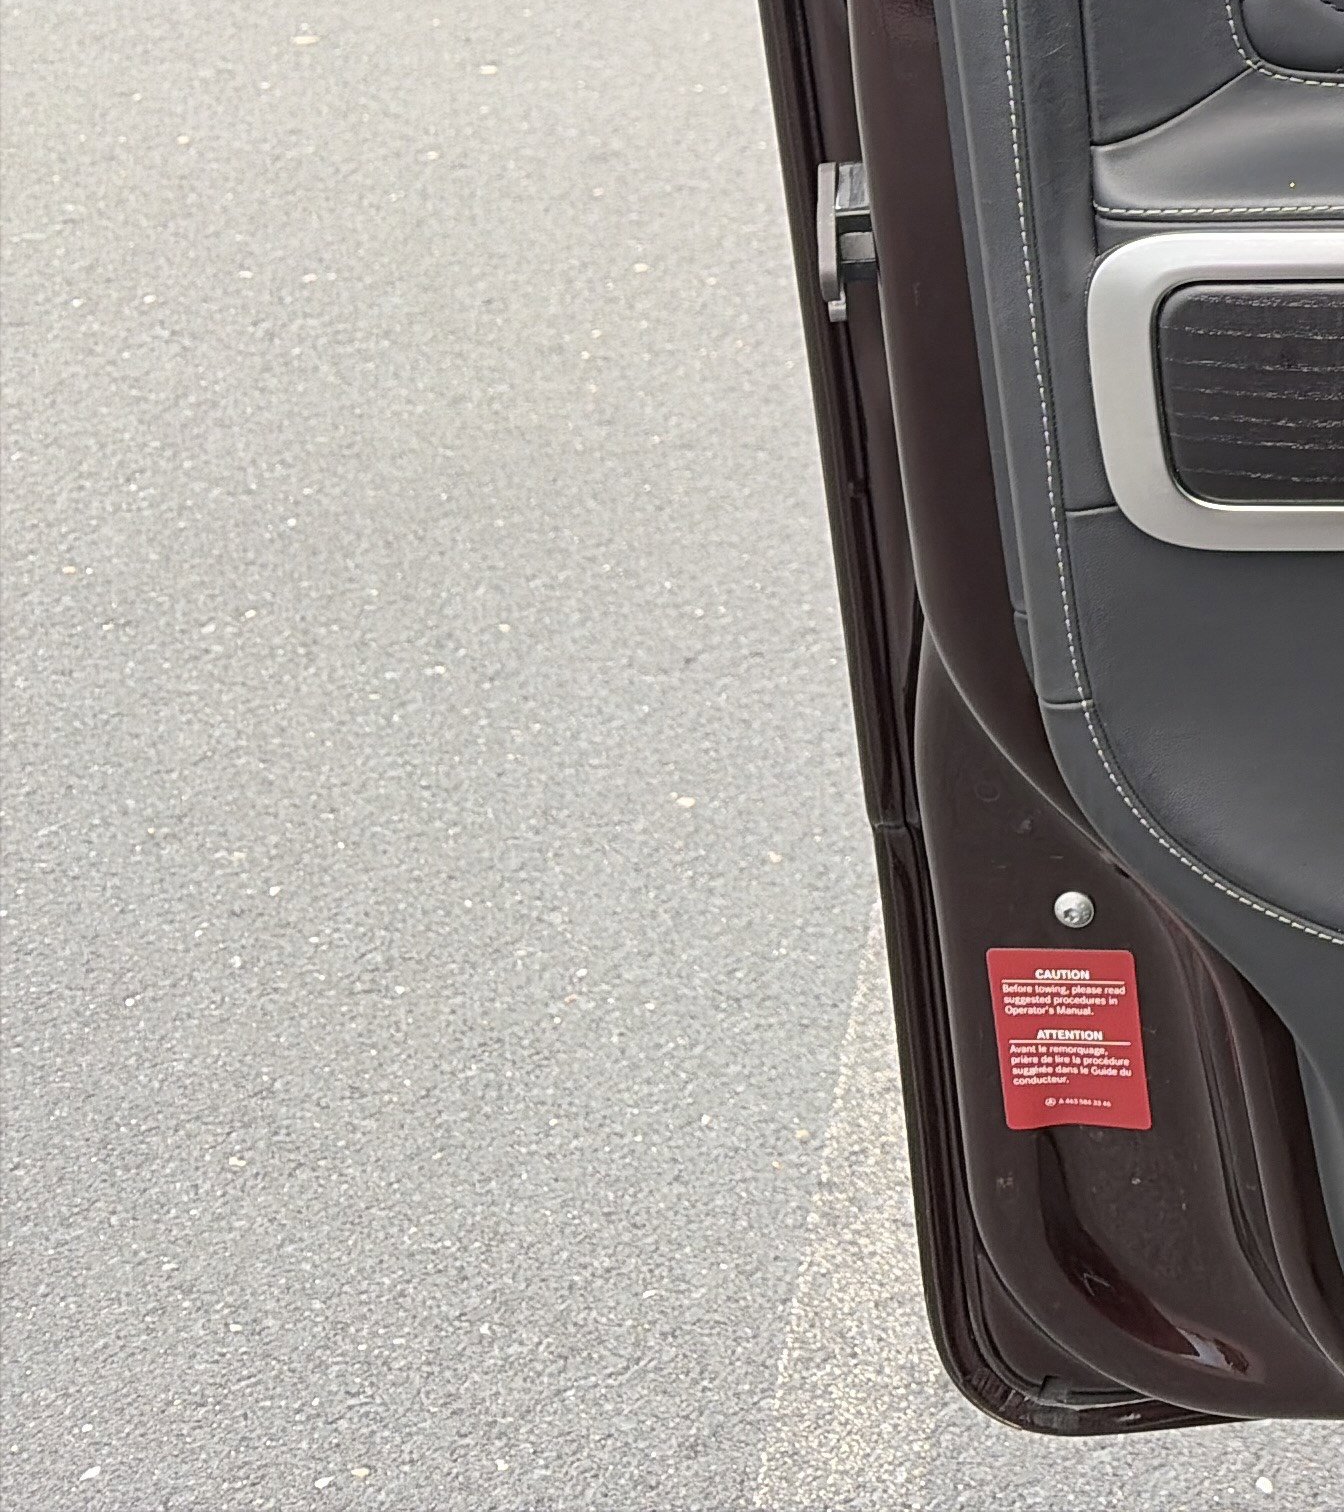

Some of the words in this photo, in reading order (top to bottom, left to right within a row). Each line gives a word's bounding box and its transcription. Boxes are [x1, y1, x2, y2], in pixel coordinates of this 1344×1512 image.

[1034, 968, 1090, 980] CAUTION
[1002, 984, 1033, 994] Before
[1034, 985, 1070, 995] towing,
[1071, 985, 1102, 996] please
[1104, 986, 1126, 995] read
[1003, 995, 1051, 1006] suggested
[1053, 996, 1107, 1006] procedures
[1108, 996, 1118, 1005] in
[1004, 1005, 1055, 1016] Operator's
[1056, 1006, 1095, 1016] Manual.
[1036, 1029, 1103, 1041] ATTENTION
[1009, 1045, 1036, 1053] Avant
[1038, 1045, 1047, 1053] le
[1049, 1046, 1109, 1056] remorquage,
[1040, 1055, 1053, 1064] de
[1054, 1055, 1070, 1064] lire
[1071, 1056, 1082, 1064] la
[1082, 1056, 1130, 1066] procédure
[1055, 1065, 1079, 1074] dans
[1080, 1066, 1089, 1074] le
[1090, 1066, 1118, 1076] Guide
[1119, 1067, 1132, 1076] du
[1012, 1076, 1070, 1085] conducteur.
